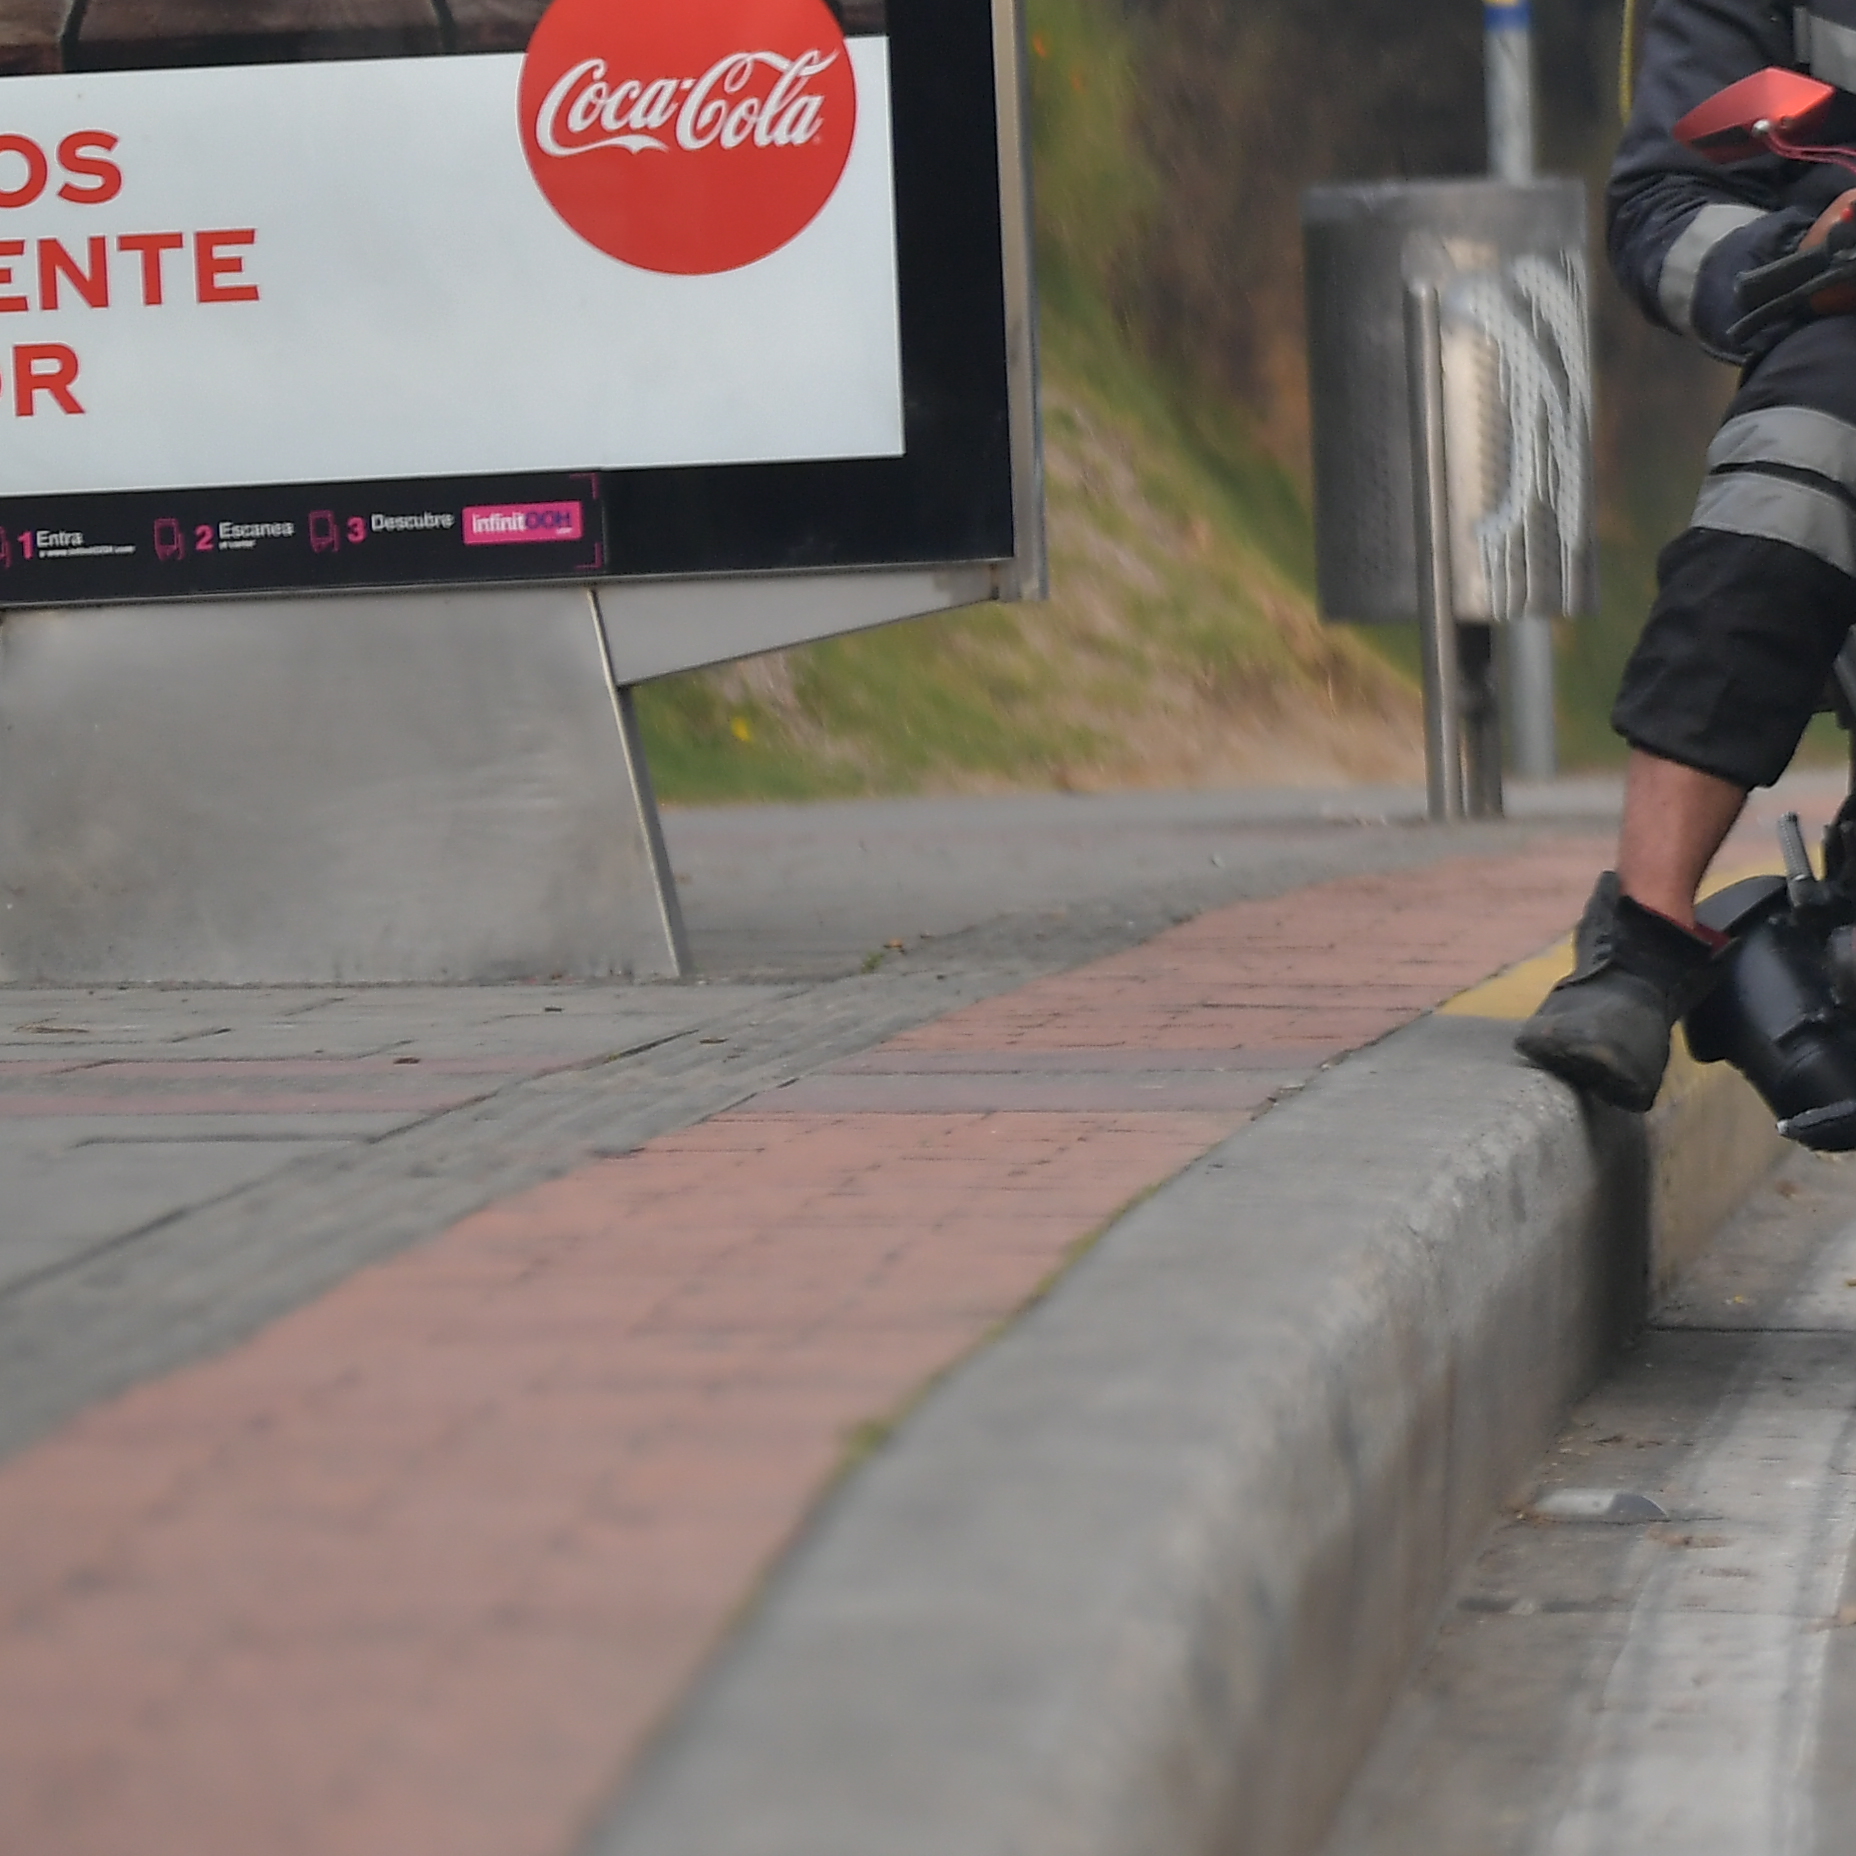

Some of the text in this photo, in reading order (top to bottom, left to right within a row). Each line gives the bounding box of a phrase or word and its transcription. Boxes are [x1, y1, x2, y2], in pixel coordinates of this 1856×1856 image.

[535, 48, 842, 158] Coca-Cola
[0, 129, 122, 208] OS
[194, 524, 214, 551] 2
[219, 520, 295, 539] Escanea
[347, 511, 455, 543] 3 Descubre
[18, 531, 34, 560] 1
[37, 529, 83, 548] Entra
